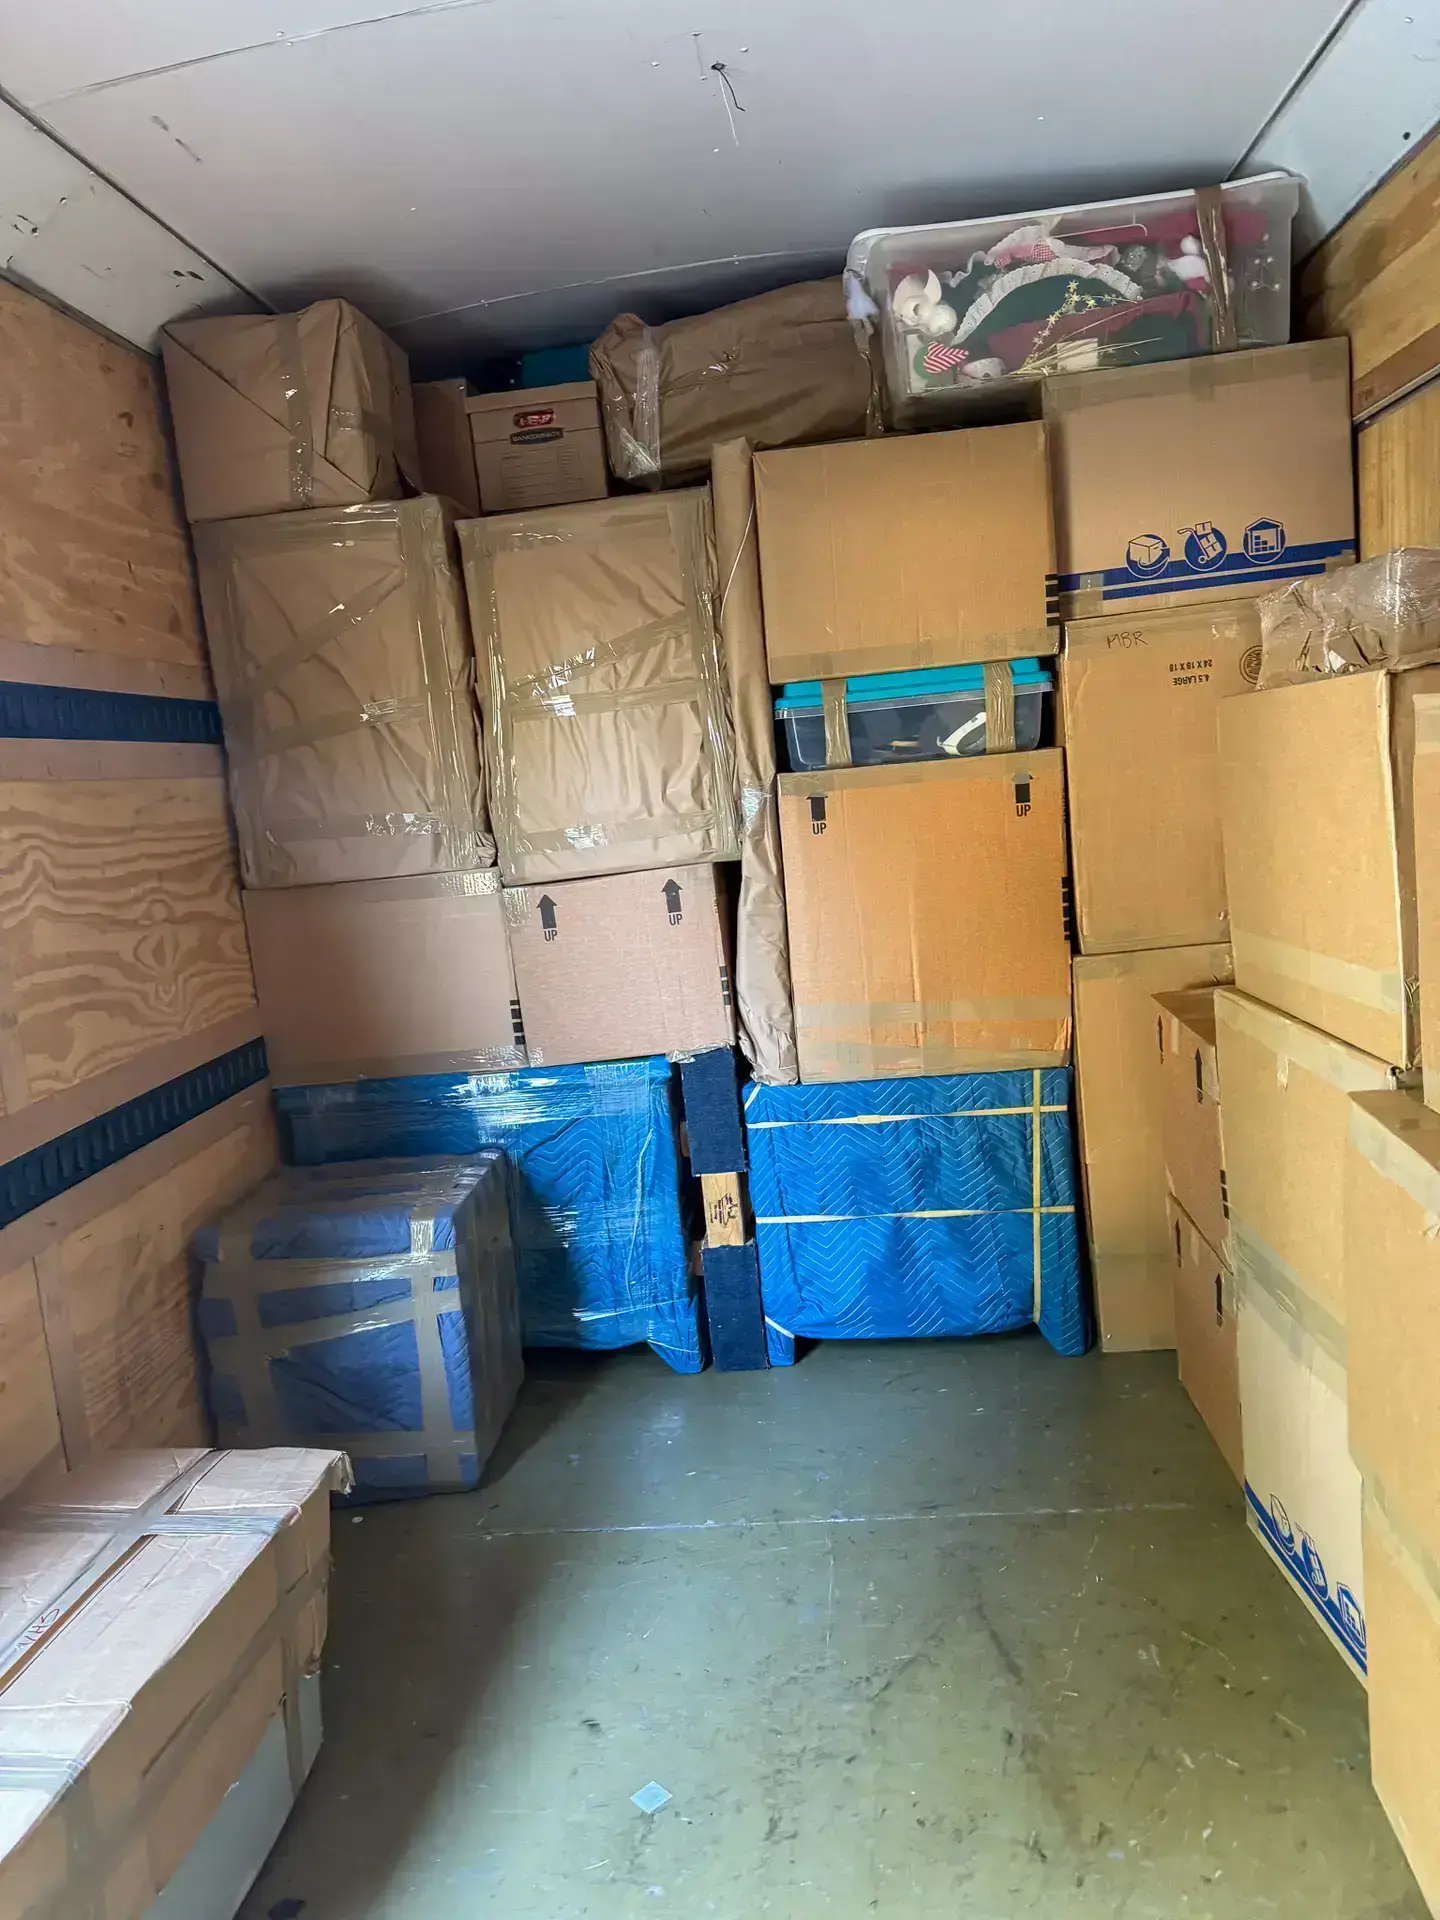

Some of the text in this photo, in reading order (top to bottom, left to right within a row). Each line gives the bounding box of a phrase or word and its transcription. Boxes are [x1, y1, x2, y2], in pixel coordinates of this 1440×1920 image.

[1106, 631, 1149, 649] MBR
[1169, 659, 1213, 672] 24 X 18 X 18
[1172, 674, 1210, 686] 4.5 LARGE
[1016, 804, 1031, 817] UP
[812, 822, 827, 835] UP
[668, 913, 683, 926] UP
[544, 929, 558, 942] UP
